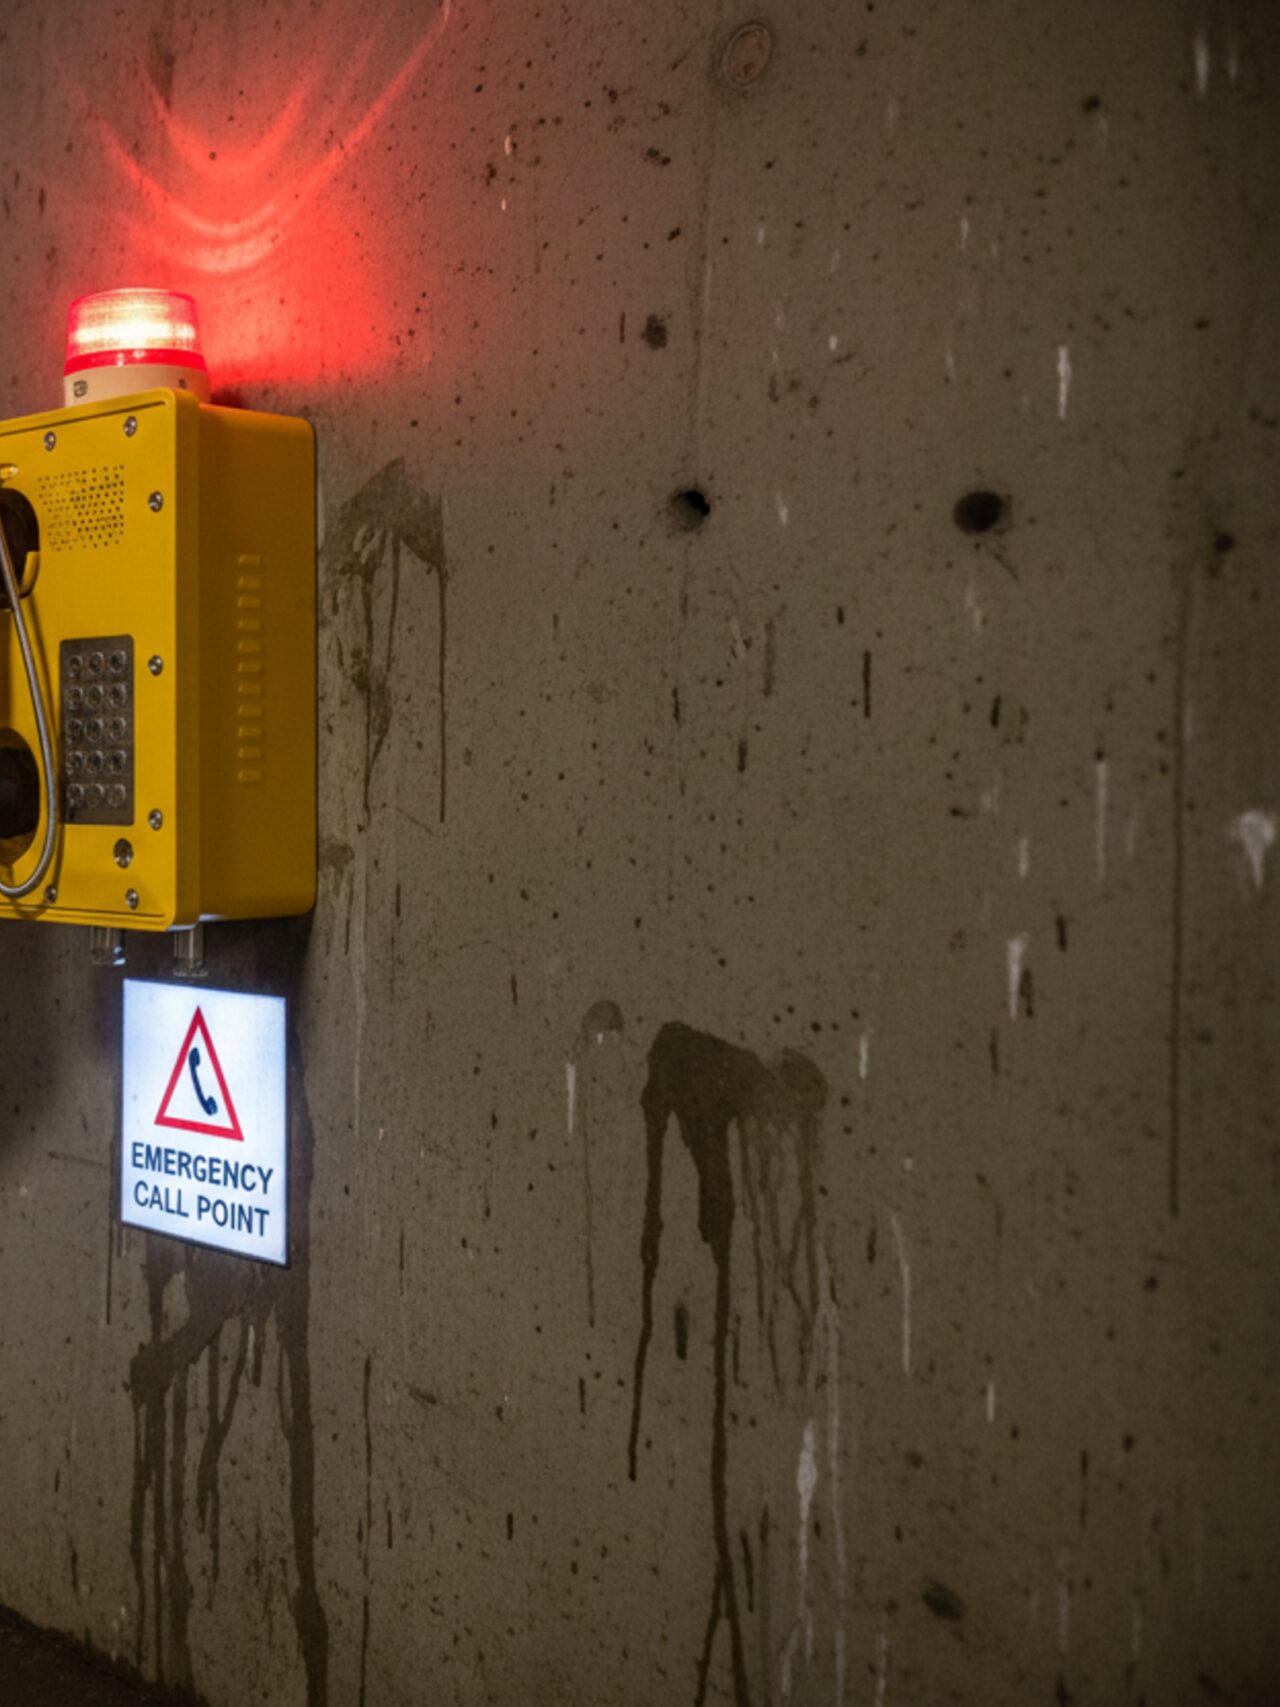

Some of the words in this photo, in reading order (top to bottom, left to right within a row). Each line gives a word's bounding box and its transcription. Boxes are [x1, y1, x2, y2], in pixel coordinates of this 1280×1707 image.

[132, 1142, 273, 1194] EMERGENCY
[134, 1180, 189, 1217] CALL
[197, 1195, 270, 1236] POINT
